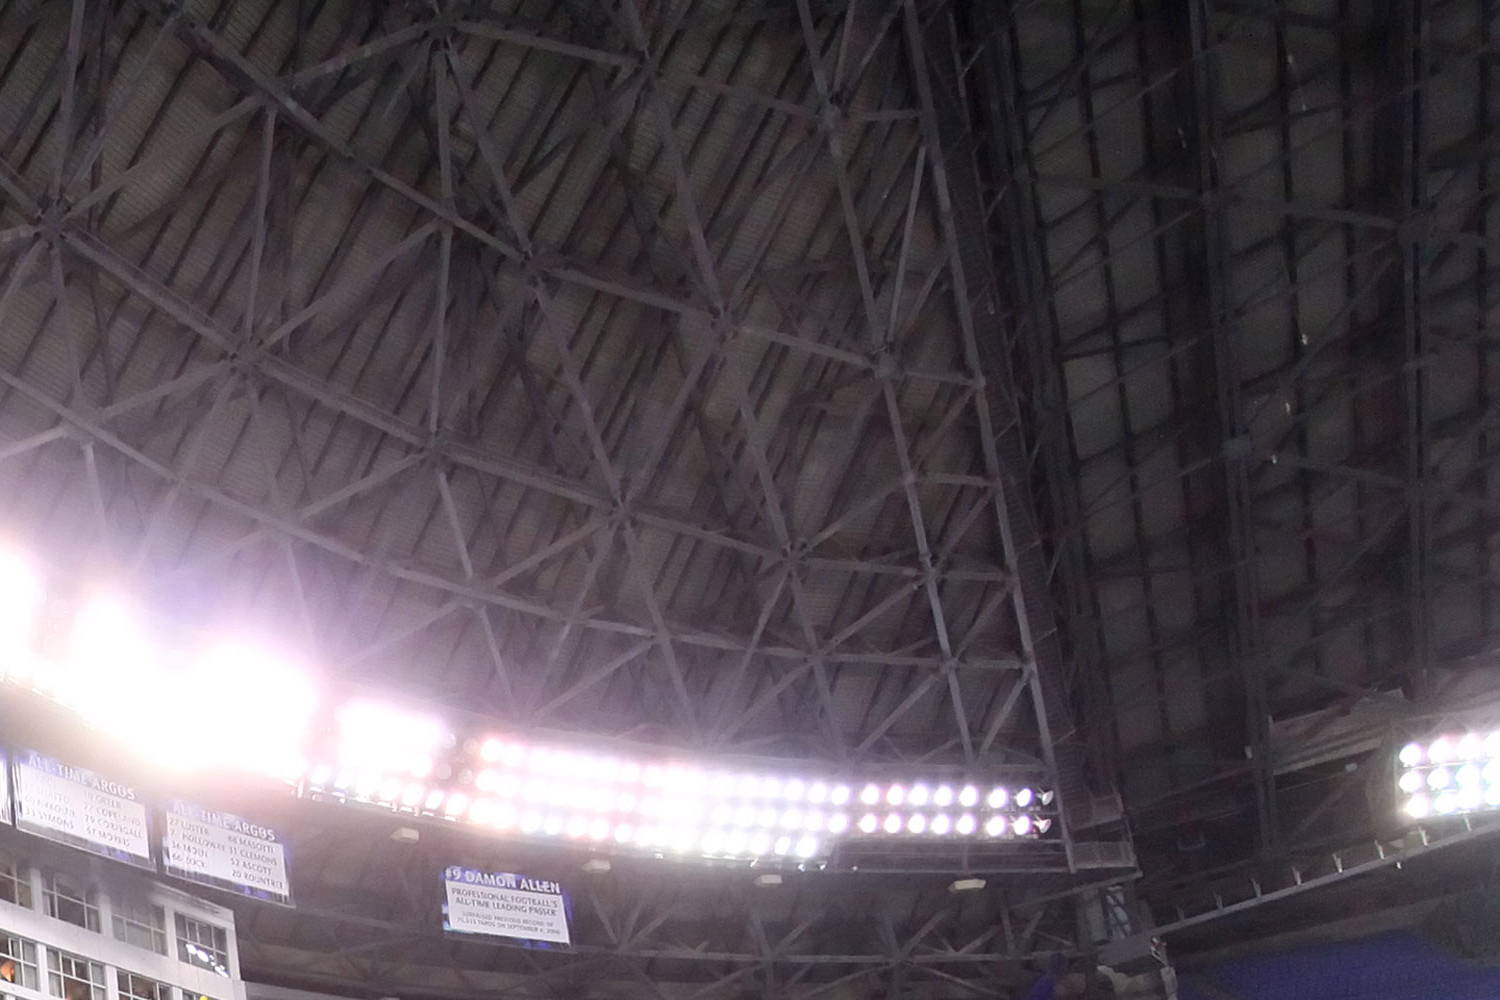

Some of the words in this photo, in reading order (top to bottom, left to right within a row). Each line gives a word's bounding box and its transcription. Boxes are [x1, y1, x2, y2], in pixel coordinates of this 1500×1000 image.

[92, 779, 135, 799] ARGOS
[233, 820, 275, 841] ARGOS
[445, 868, 461, 880] #9
[465, 871, 516, 888] DAMON
[520, 878, 561, 894] ALLEN
[451, 887, 509, 903] PROFESSIONAL
[492, 902, 527, 913] LEADING
[529, 907, 557, 917] PASSER
